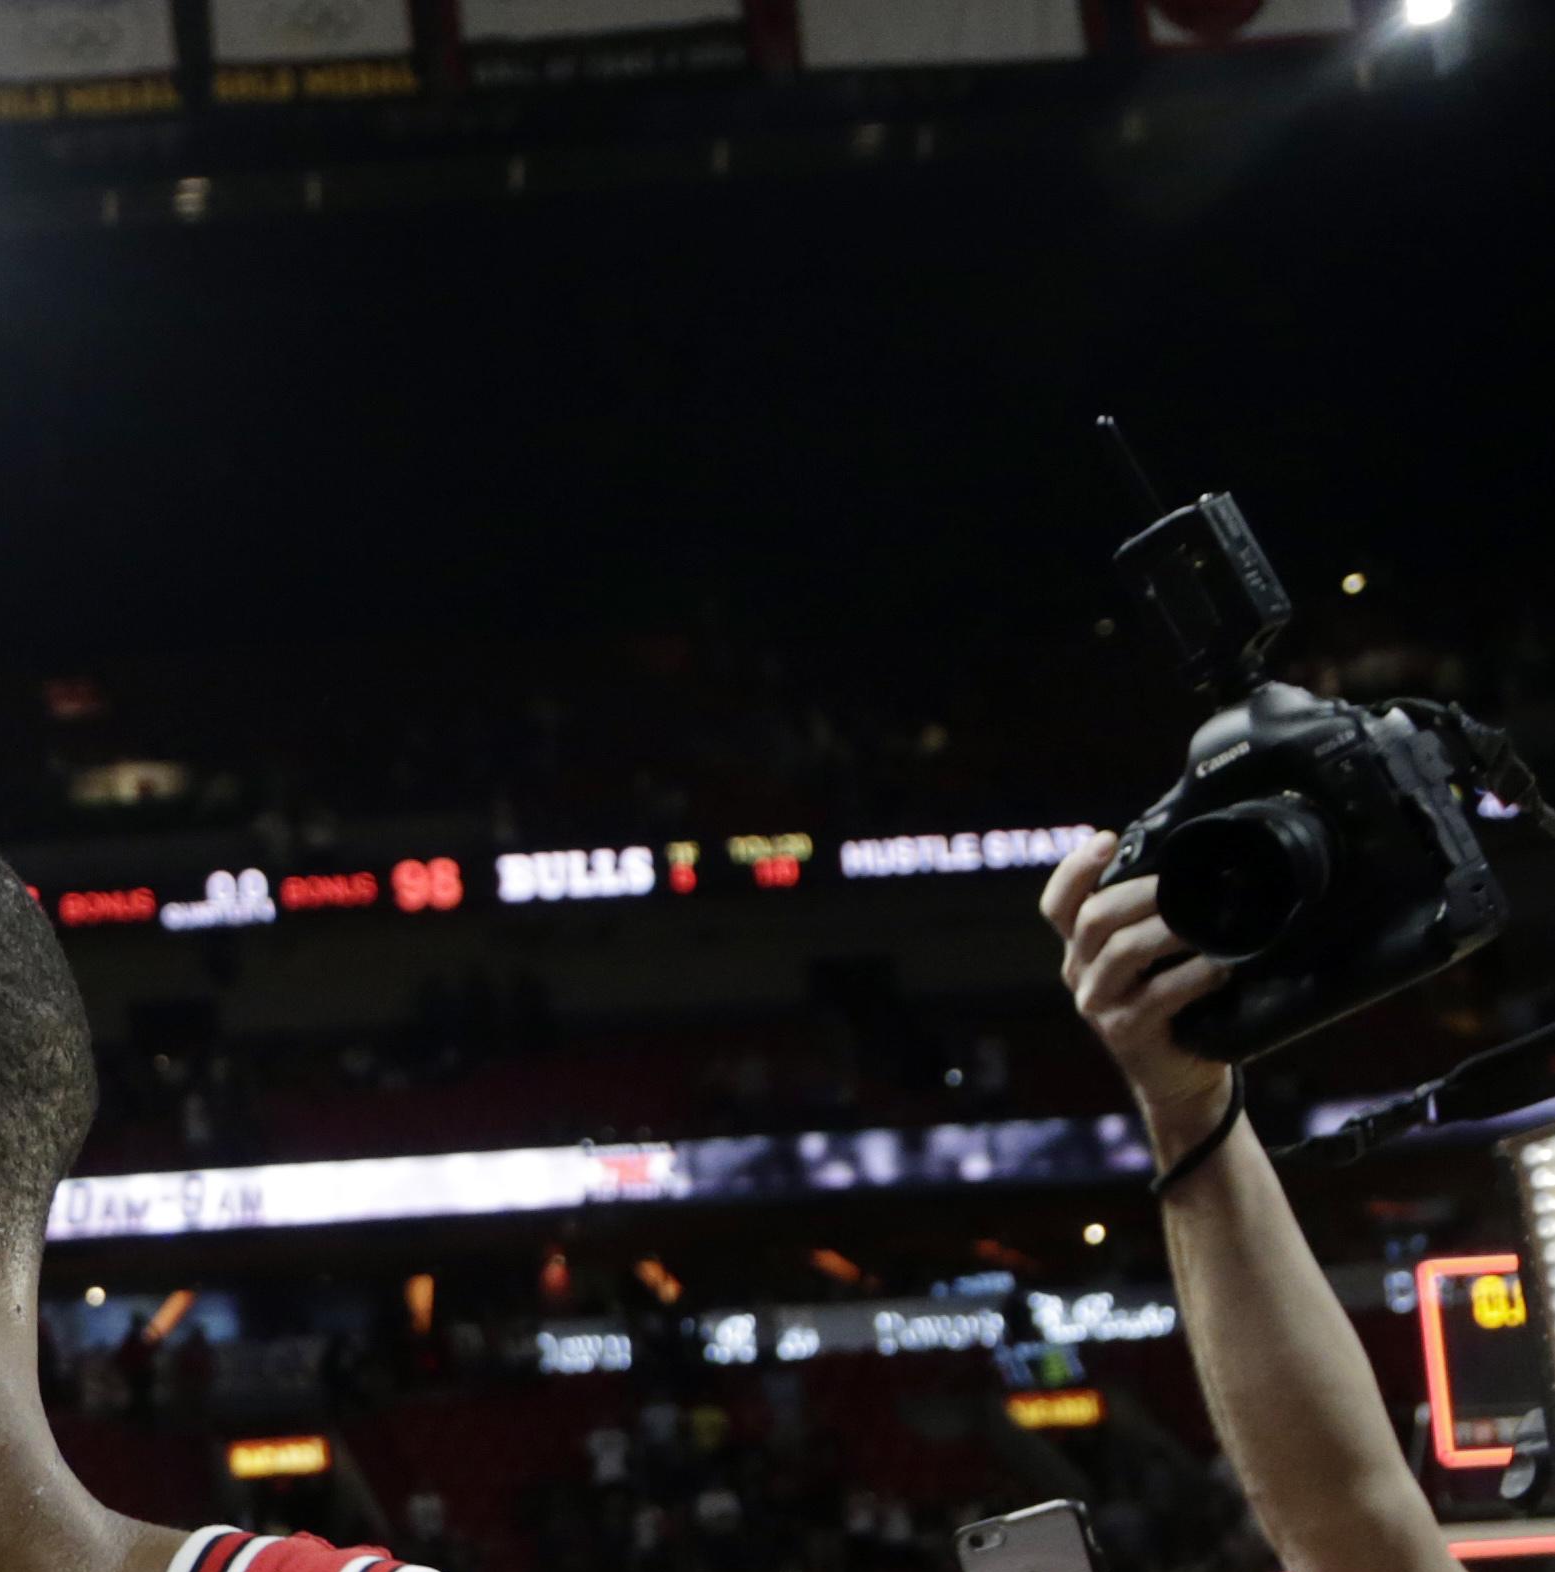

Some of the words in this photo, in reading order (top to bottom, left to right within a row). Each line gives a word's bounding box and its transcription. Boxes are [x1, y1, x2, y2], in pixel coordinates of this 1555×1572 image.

[1194, 740, 1251, 779] Canon
[495, 845, 656, 904] BULLS
[839, 830, 979, 880] HUSTLE
